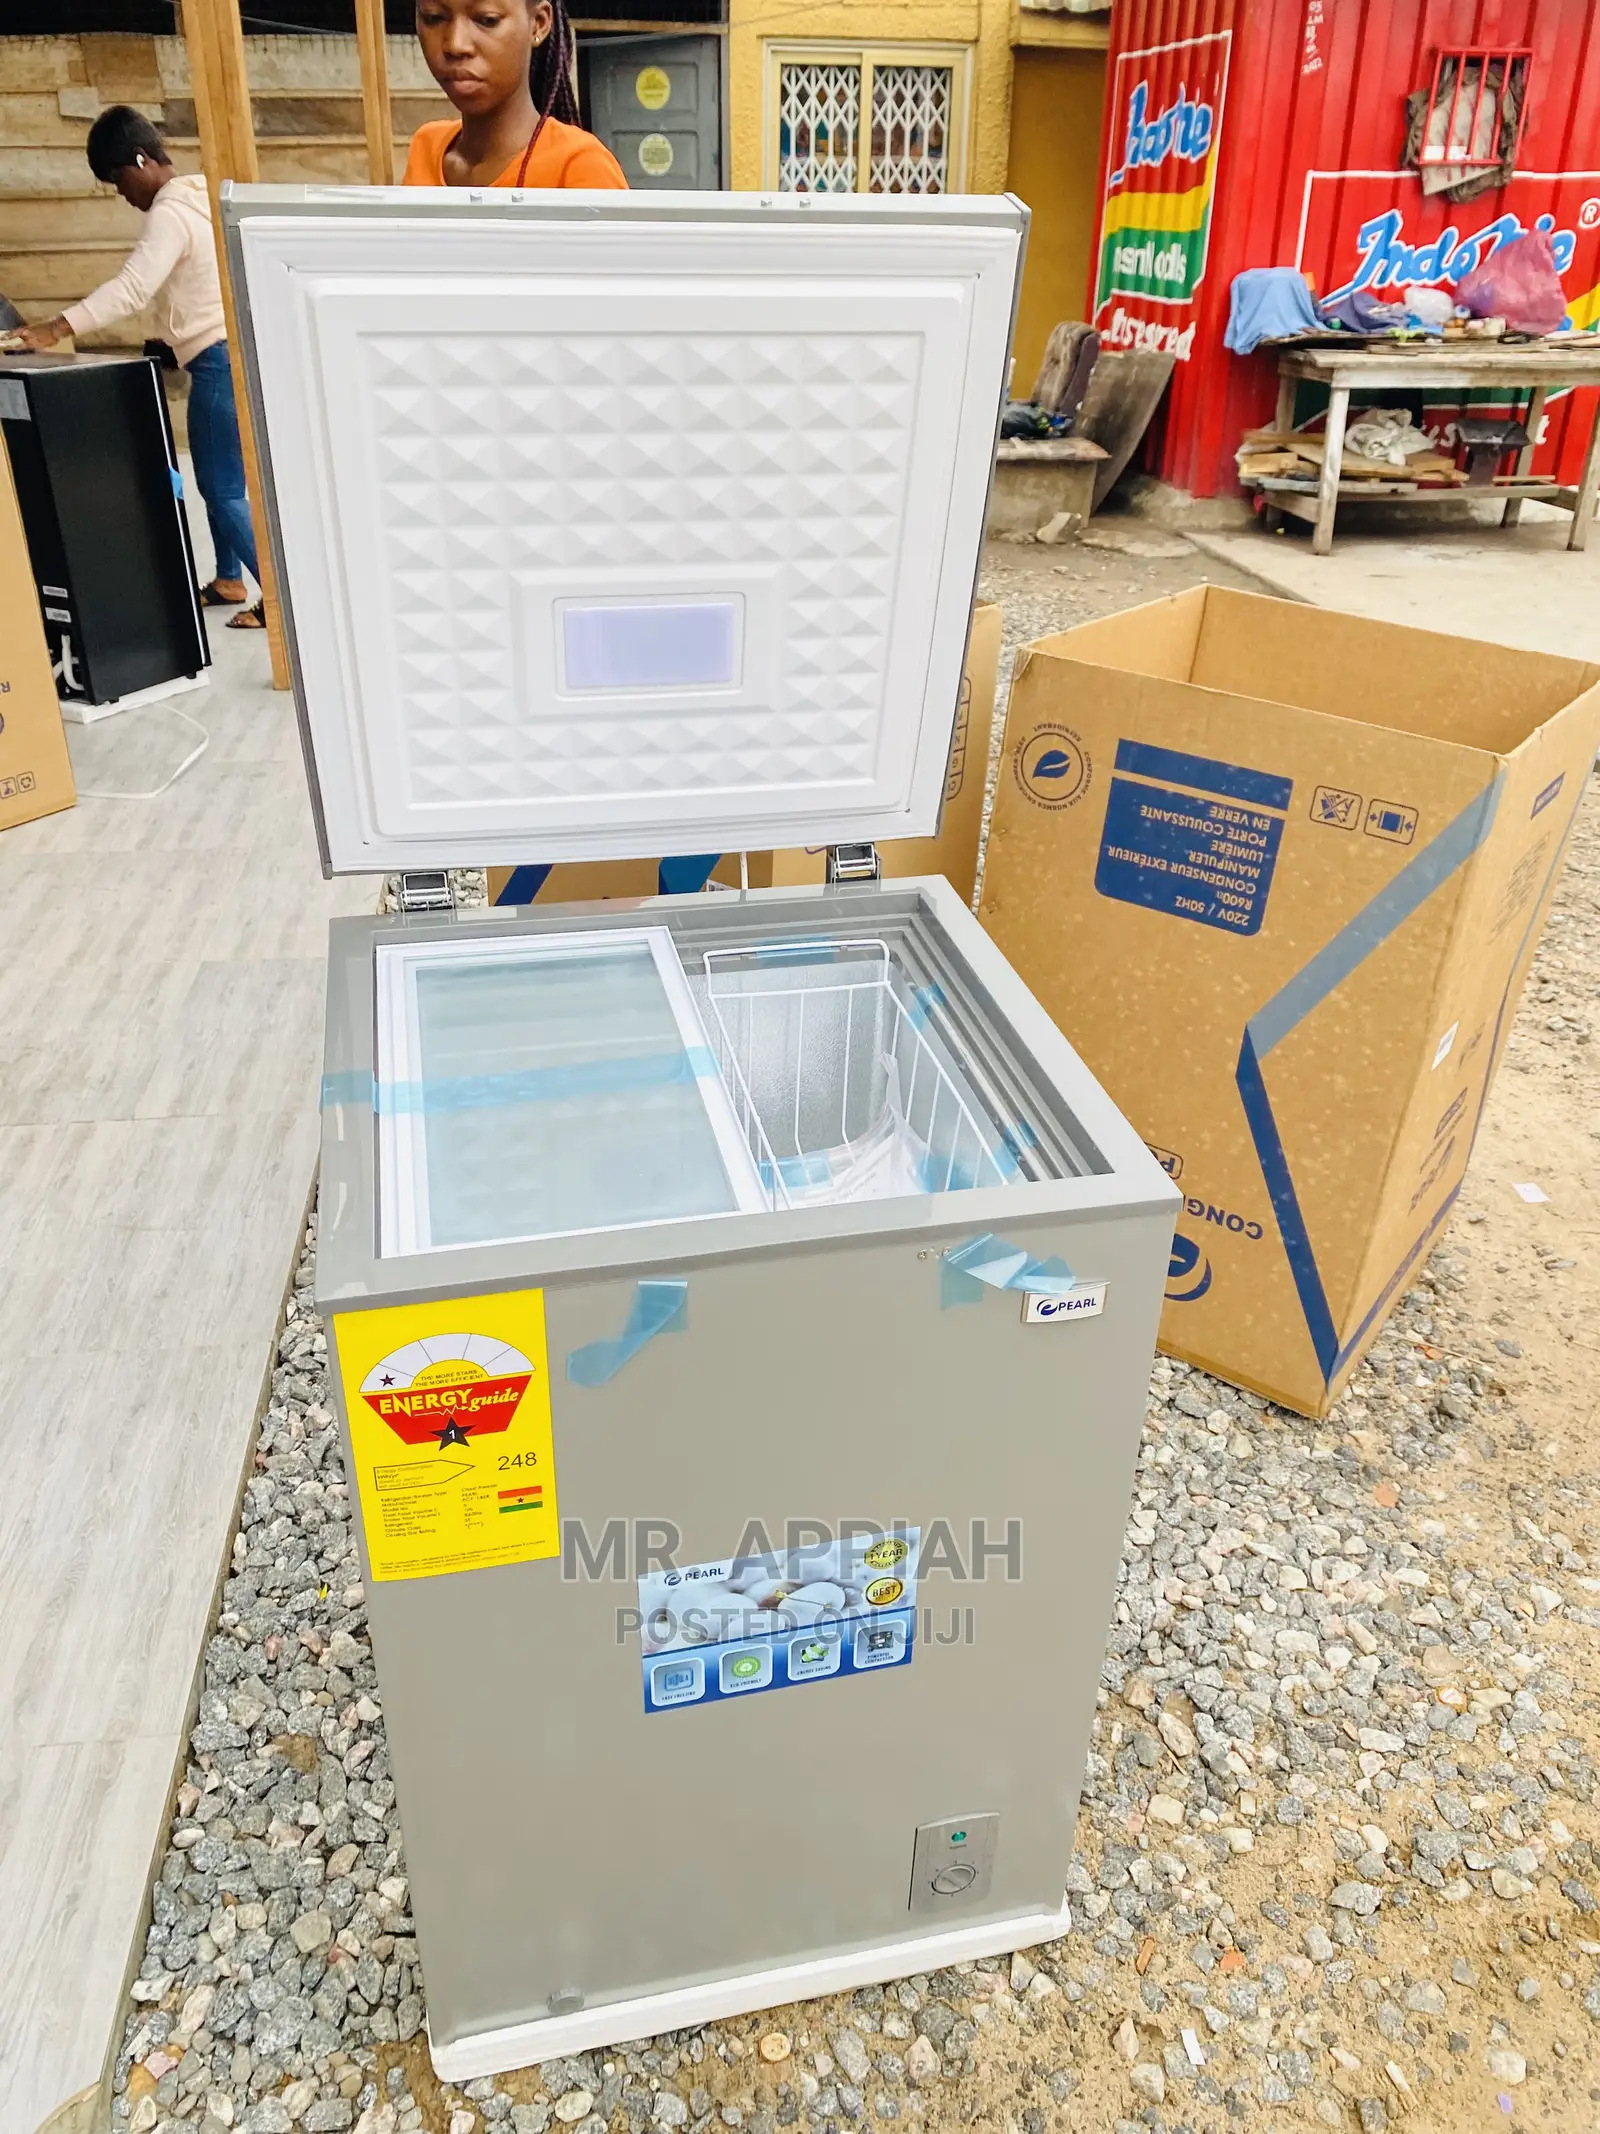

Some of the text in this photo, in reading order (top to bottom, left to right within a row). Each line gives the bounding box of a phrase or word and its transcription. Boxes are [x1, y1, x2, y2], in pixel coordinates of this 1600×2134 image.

[1140, 805, 1267, 848] PORTE COULISSANTE
[1208, 806, 1271, 831] EN VERRE
[1188, 849, 1260, 879] MANIPULER
[1170, 861, 1257, 895] CONDENSEUR
[1175, 894, 1206, 914] 50HZ
[1218, 907, 1250, 927] 220V
[1183, 1194, 1264, 1240] CONG
[1058, 1297, 1097, 1312] PEARL
[379, 1387, 519, 1417] ENERGY guide
[449, 1429, 456, 1440] 1
[497, 1451, 537, 1471] 248
[875, 1548, 903, 1559] YEAR
[685, 1567, 724, 1581] PEARL
[872, 1585, 897, 1598] BEST
